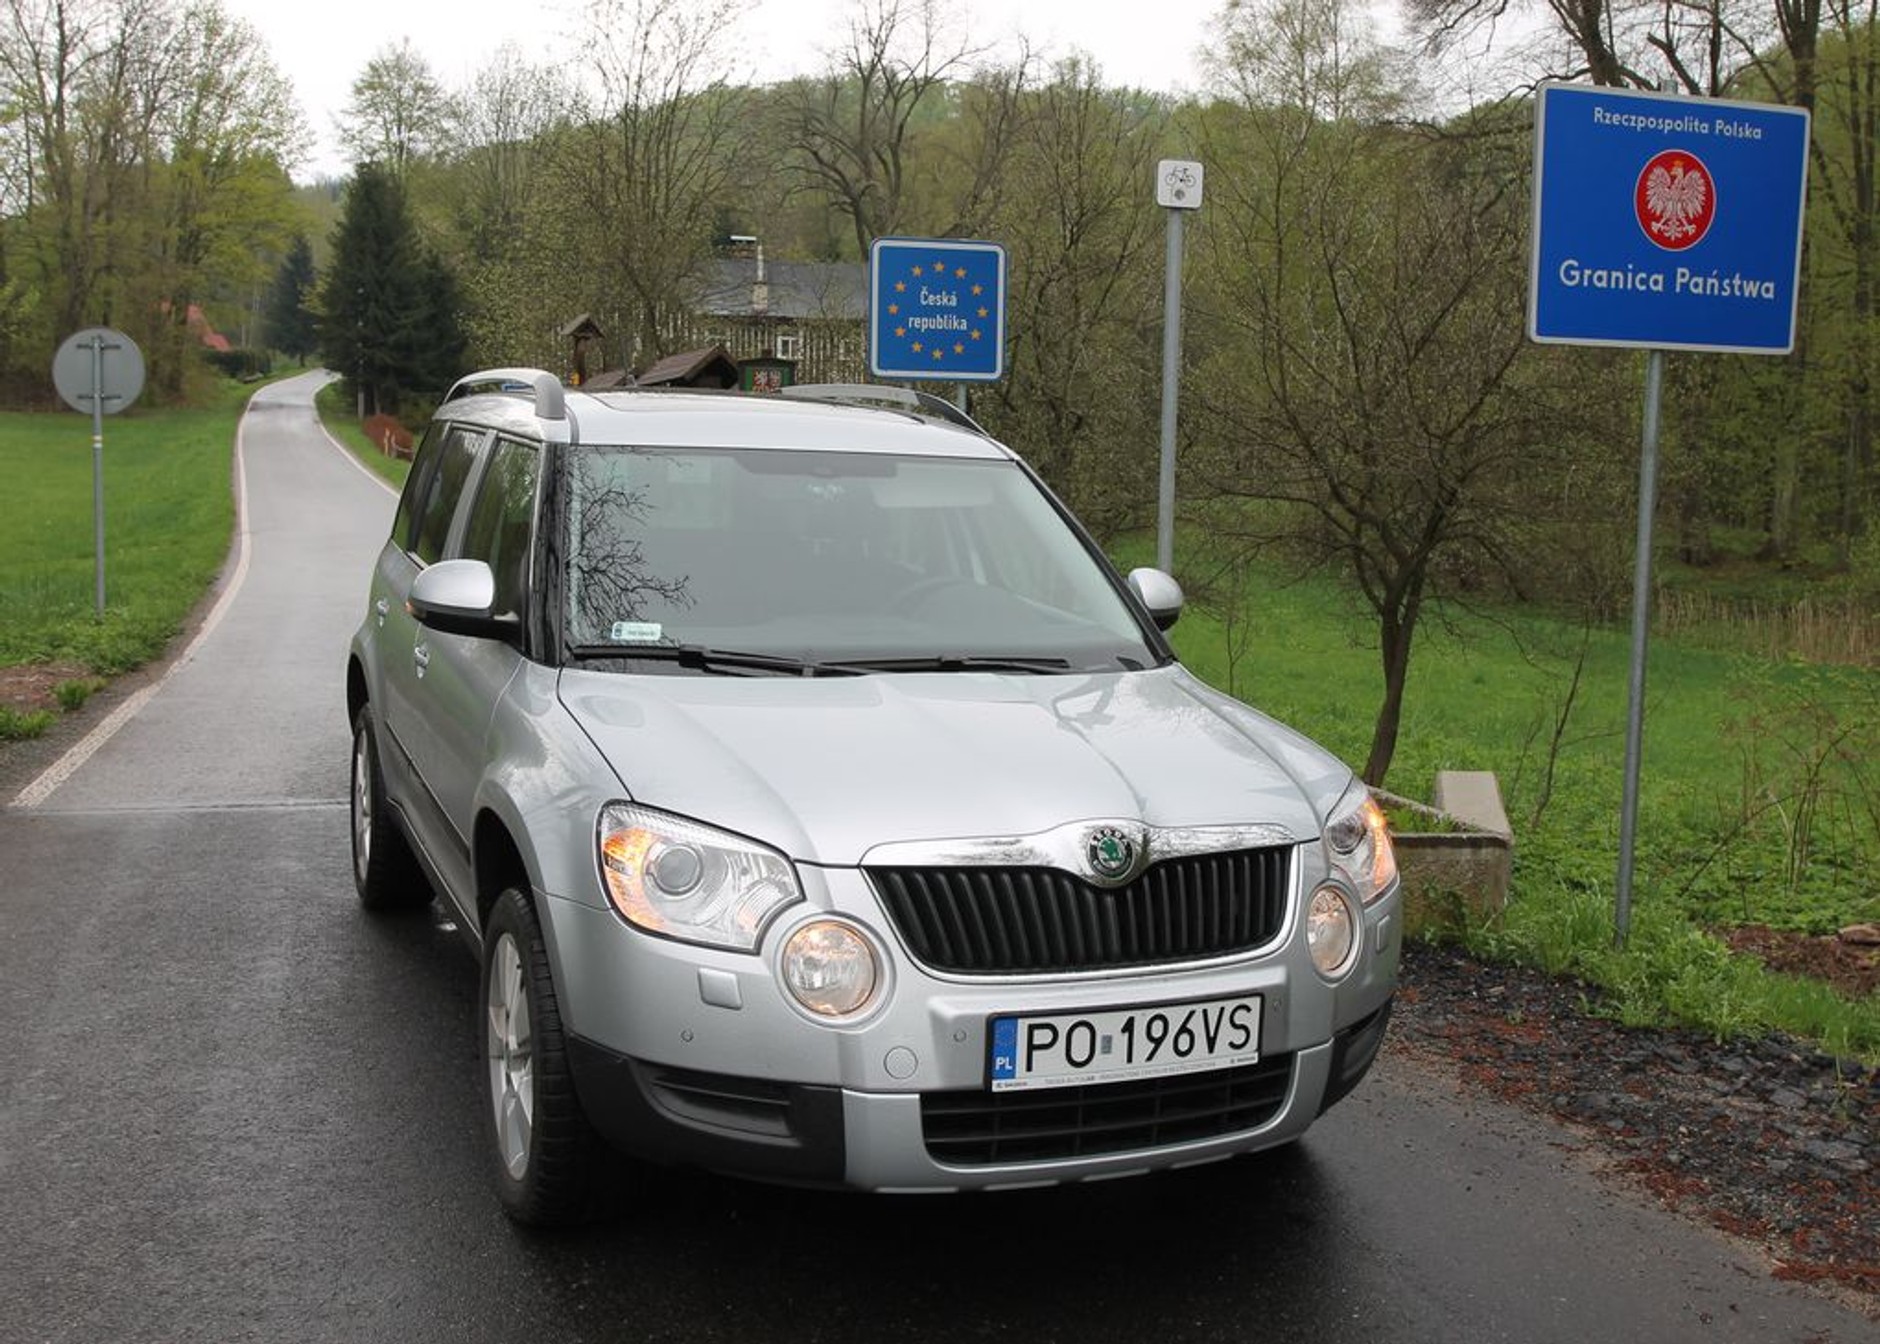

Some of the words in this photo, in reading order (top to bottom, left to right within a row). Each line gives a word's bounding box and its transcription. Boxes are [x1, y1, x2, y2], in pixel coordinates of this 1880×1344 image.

[1594, 107, 1709, 134] Rzeczpospolita
[1715, 119, 1762, 139] Polska
[1559, 259, 1664, 292] Granica
[1675, 267, 1775, 299] Państwa
[919, 286, 958, 306] Česká
[908, 315, 968, 332] republika
[1025, 1019, 1097, 1072] PO
[1120, 1003, 1253, 1064] 196VS
[995, 1056, 1013, 1071] PL
